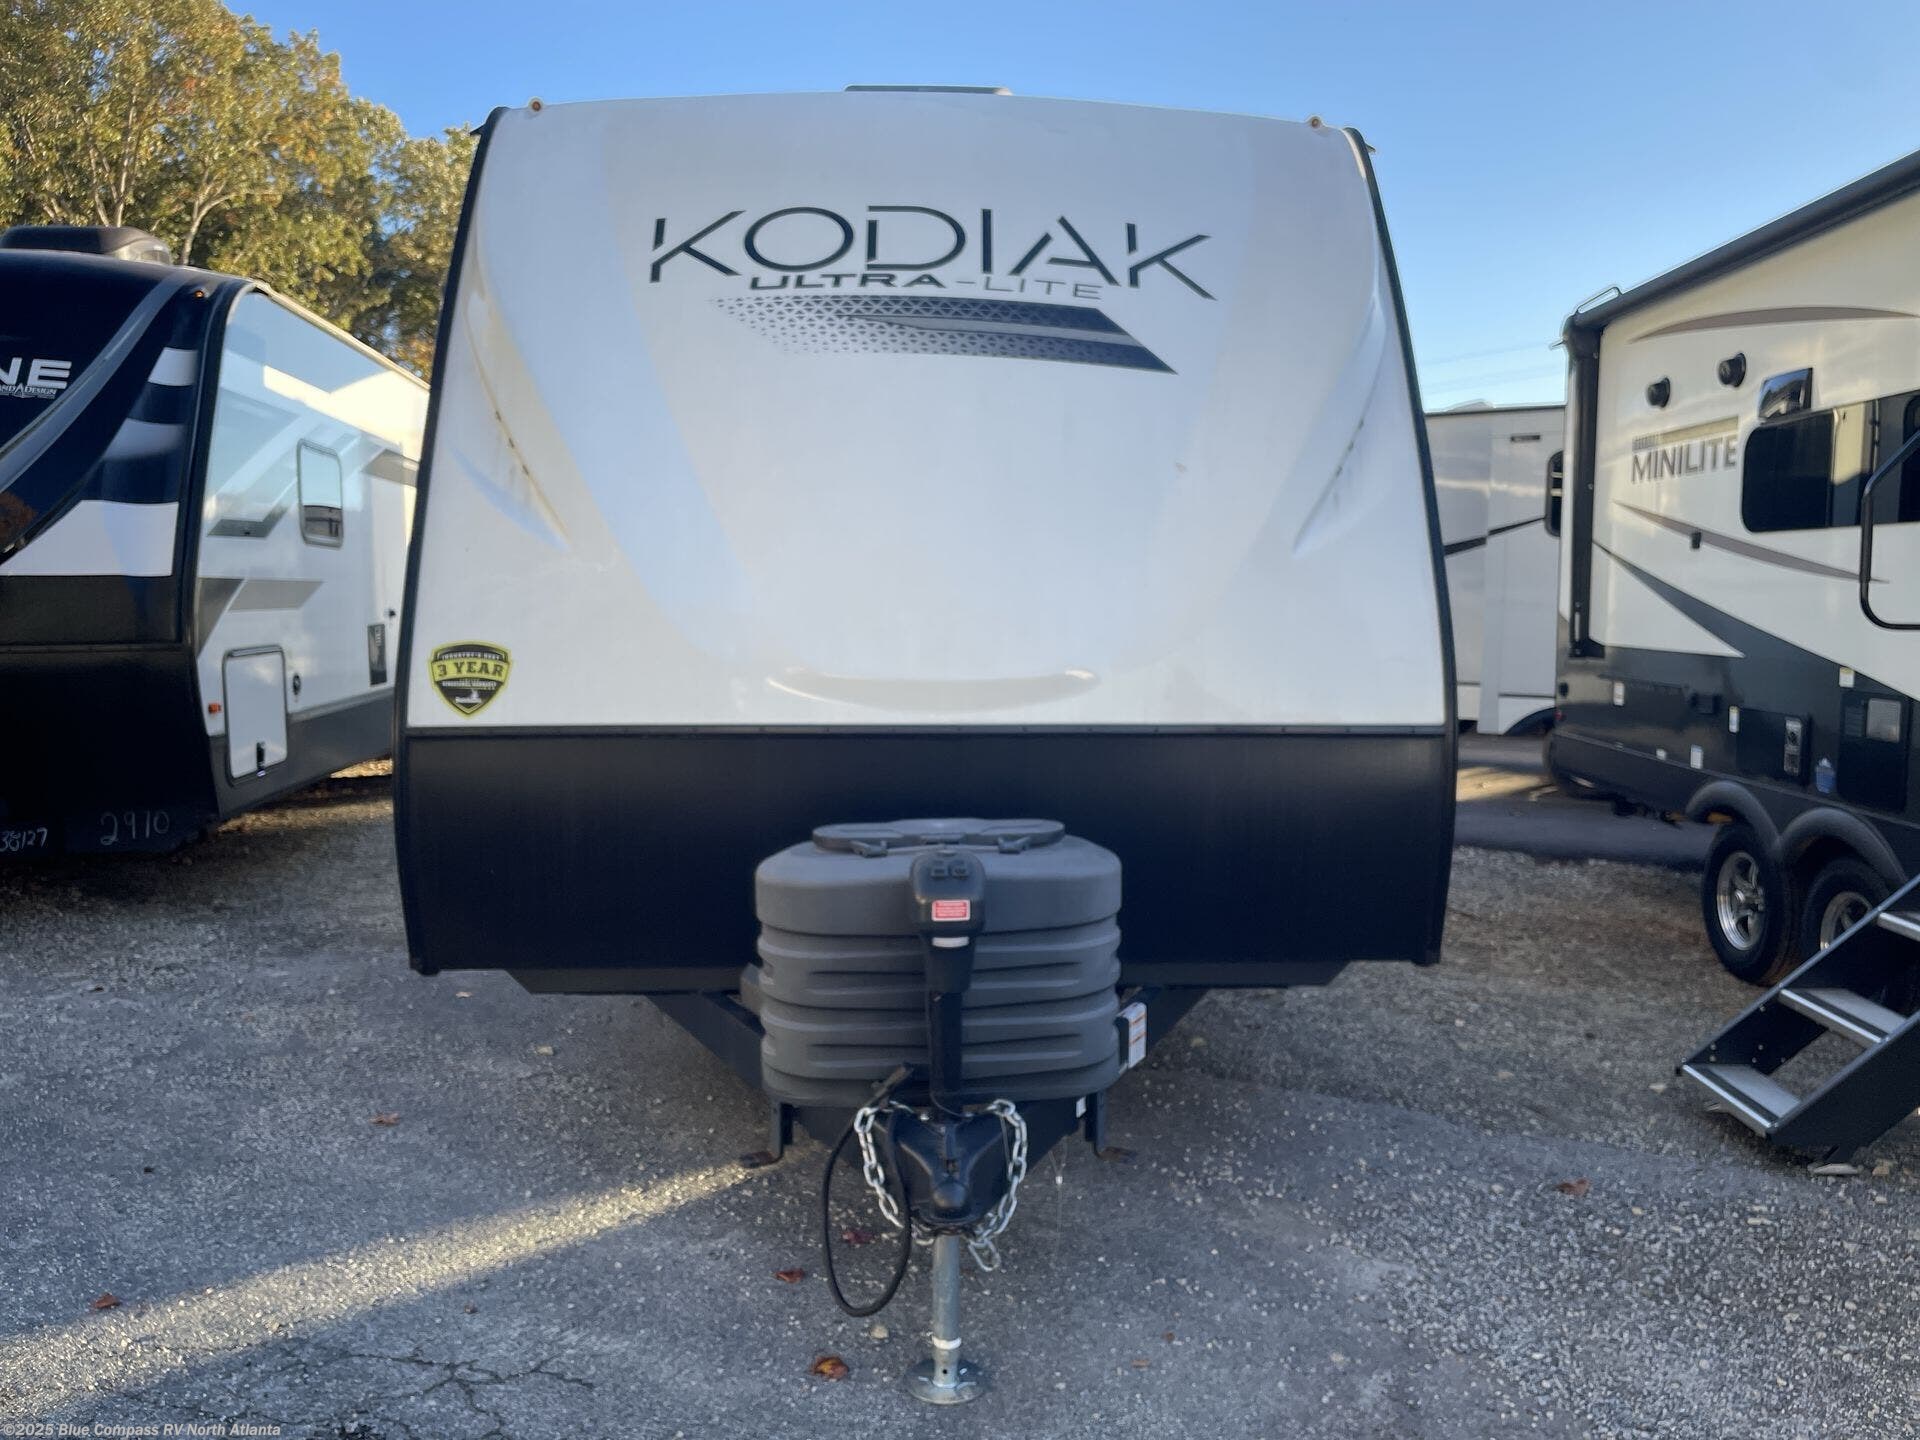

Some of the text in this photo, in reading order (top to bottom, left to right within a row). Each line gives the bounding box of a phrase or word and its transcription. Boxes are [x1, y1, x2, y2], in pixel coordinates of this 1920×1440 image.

[650, 205, 1218, 301] KODIAK
[750, 272, 1102, 299] ULTRA-LITE
[1631, 436, 1738, 484] MINILITE
[437, 661, 504, 677] 3 YEAR
